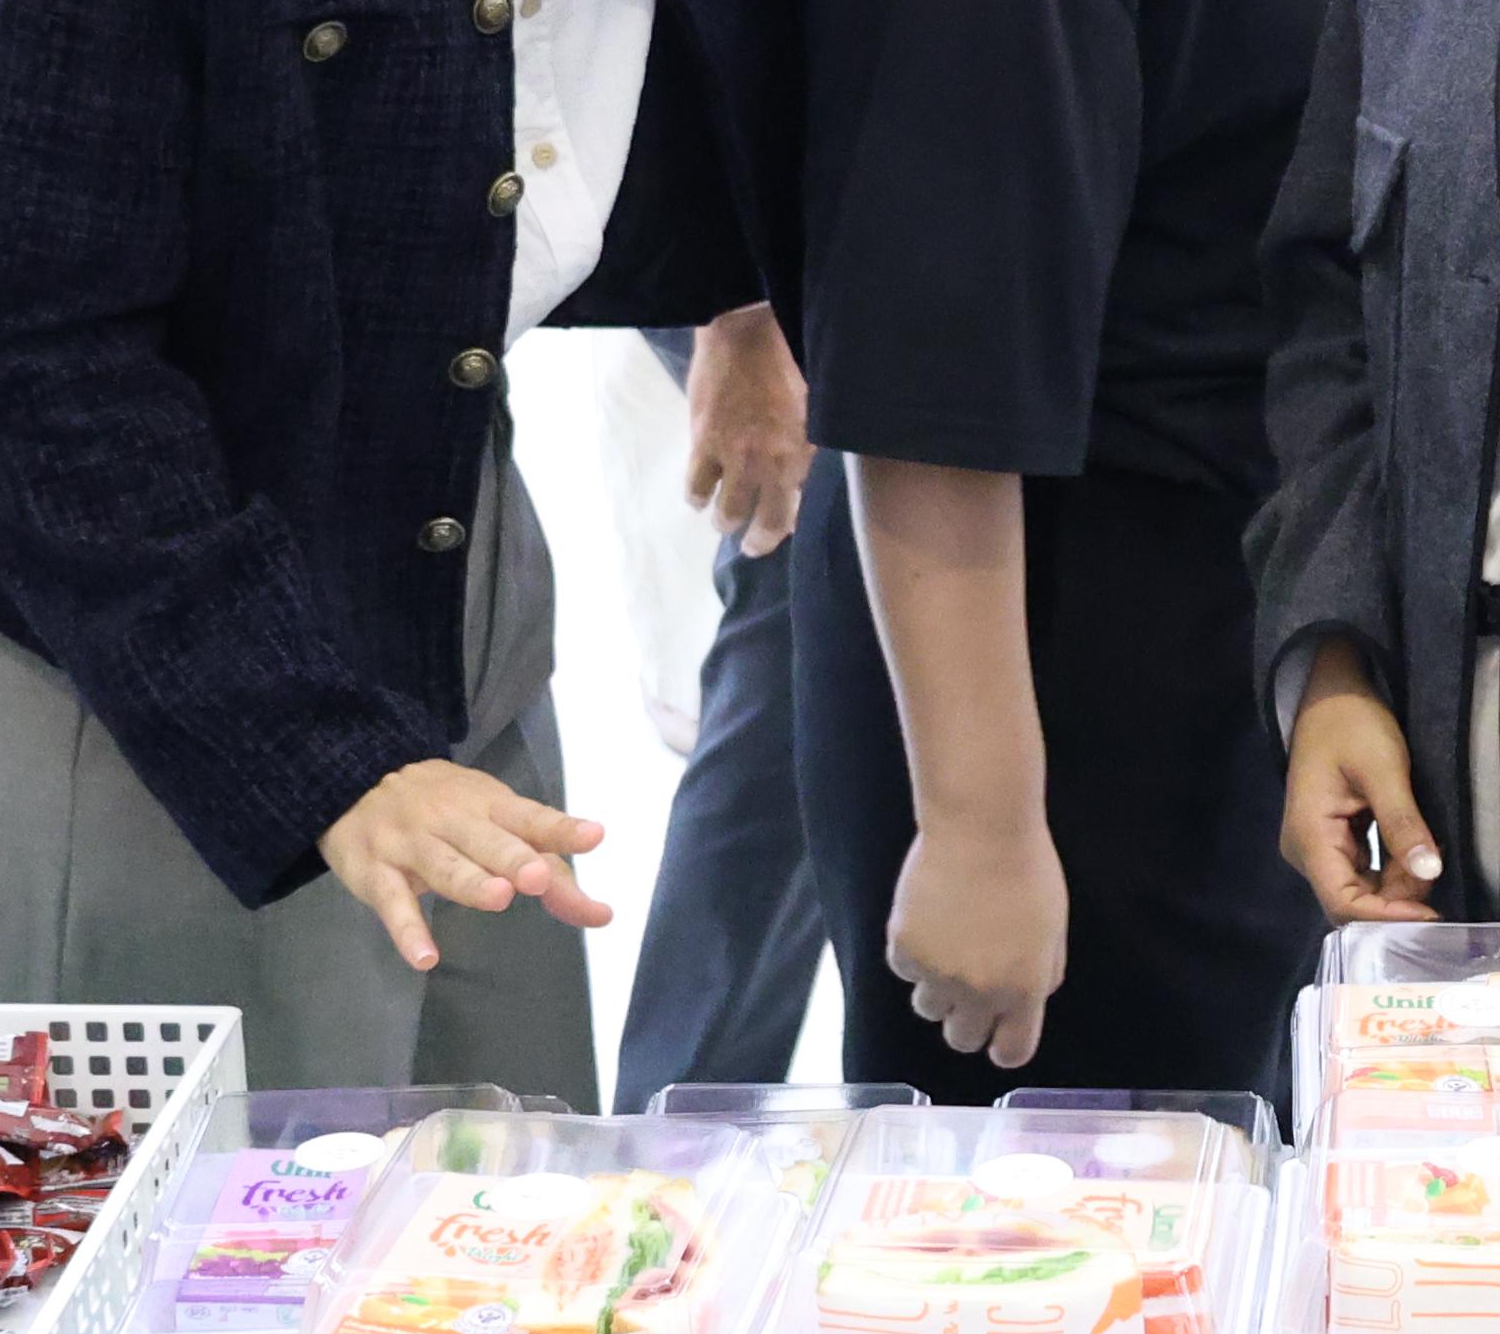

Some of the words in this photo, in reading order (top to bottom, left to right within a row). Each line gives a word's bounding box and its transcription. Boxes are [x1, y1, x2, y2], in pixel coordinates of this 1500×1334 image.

[1372, 994, 1435, 1010] Unif
[240, 1179, 352, 1207] fresh
[428, 1212, 553, 1247] fresh
